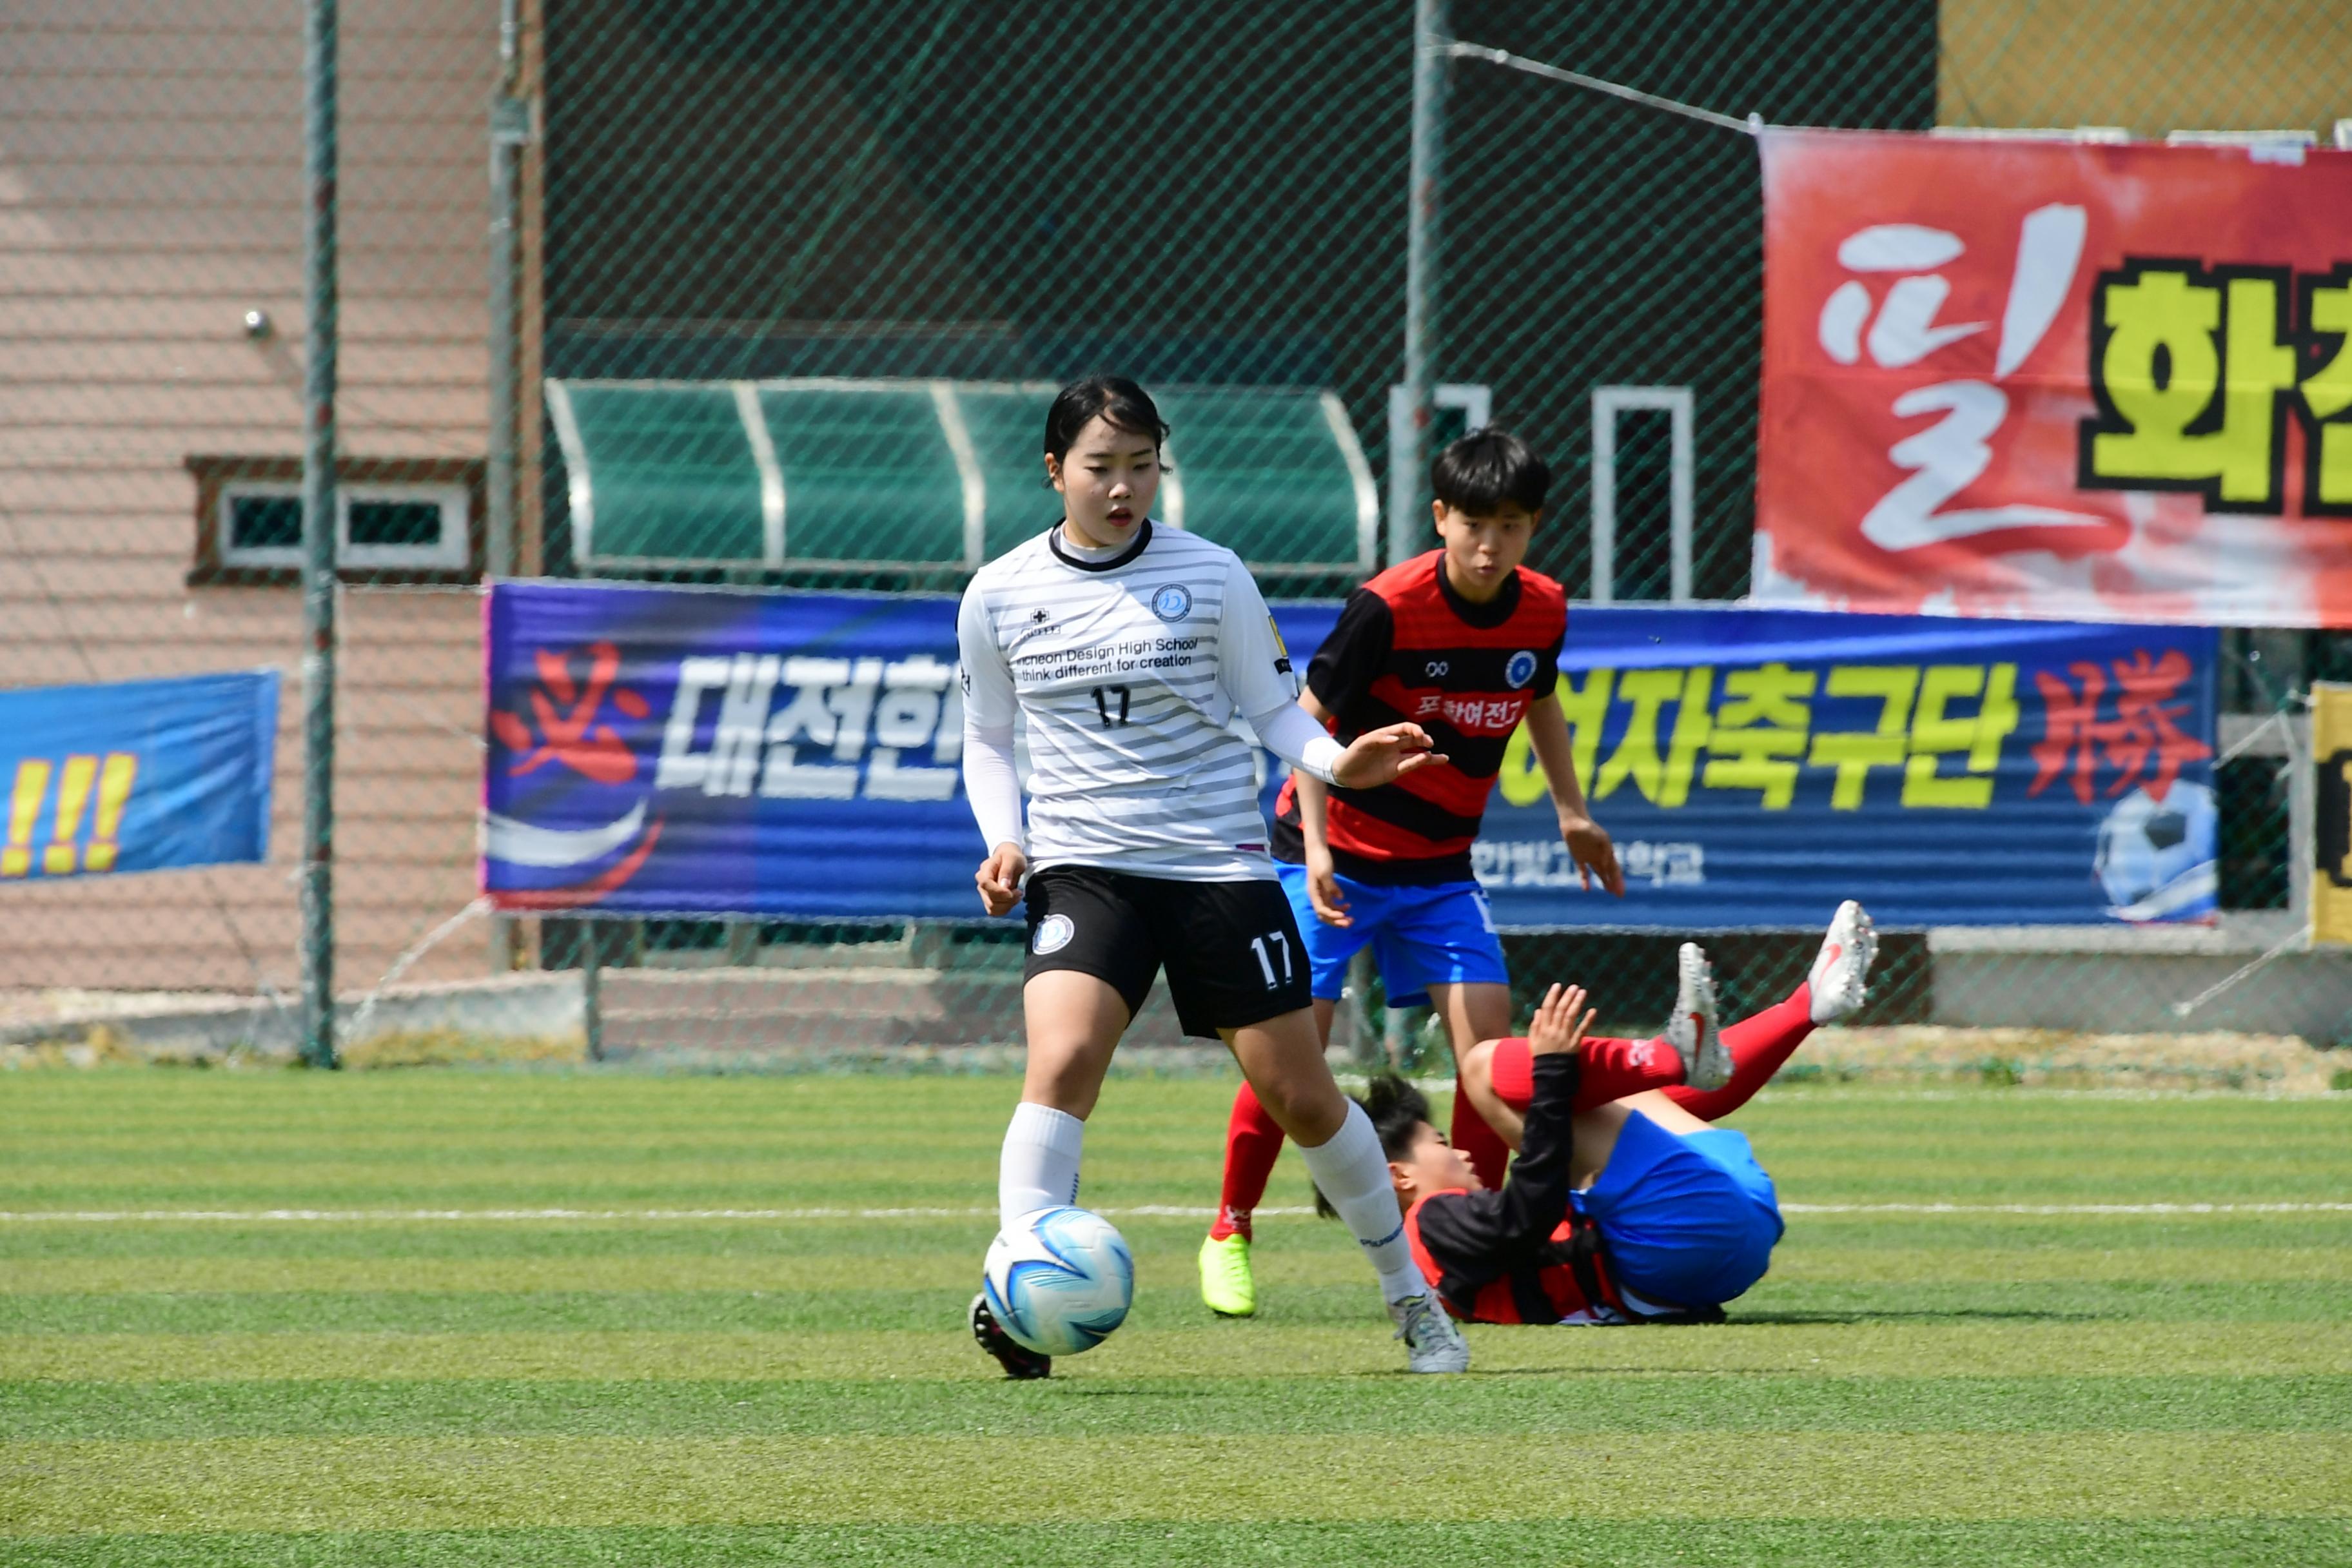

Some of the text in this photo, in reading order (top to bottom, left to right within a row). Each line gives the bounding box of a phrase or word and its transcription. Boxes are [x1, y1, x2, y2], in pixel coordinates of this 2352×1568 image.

[1022, 654, 1192, 681] think different for creation
[1067, 645, 1115, 662] Design
[1119, 640, 1152, 656] High
[1156, 637, 1199, 652] School
[653, 652, 965, 801] 대전한
[1090, 683, 1131, 728] 17
[1251, 930, 1293, 992] 17
